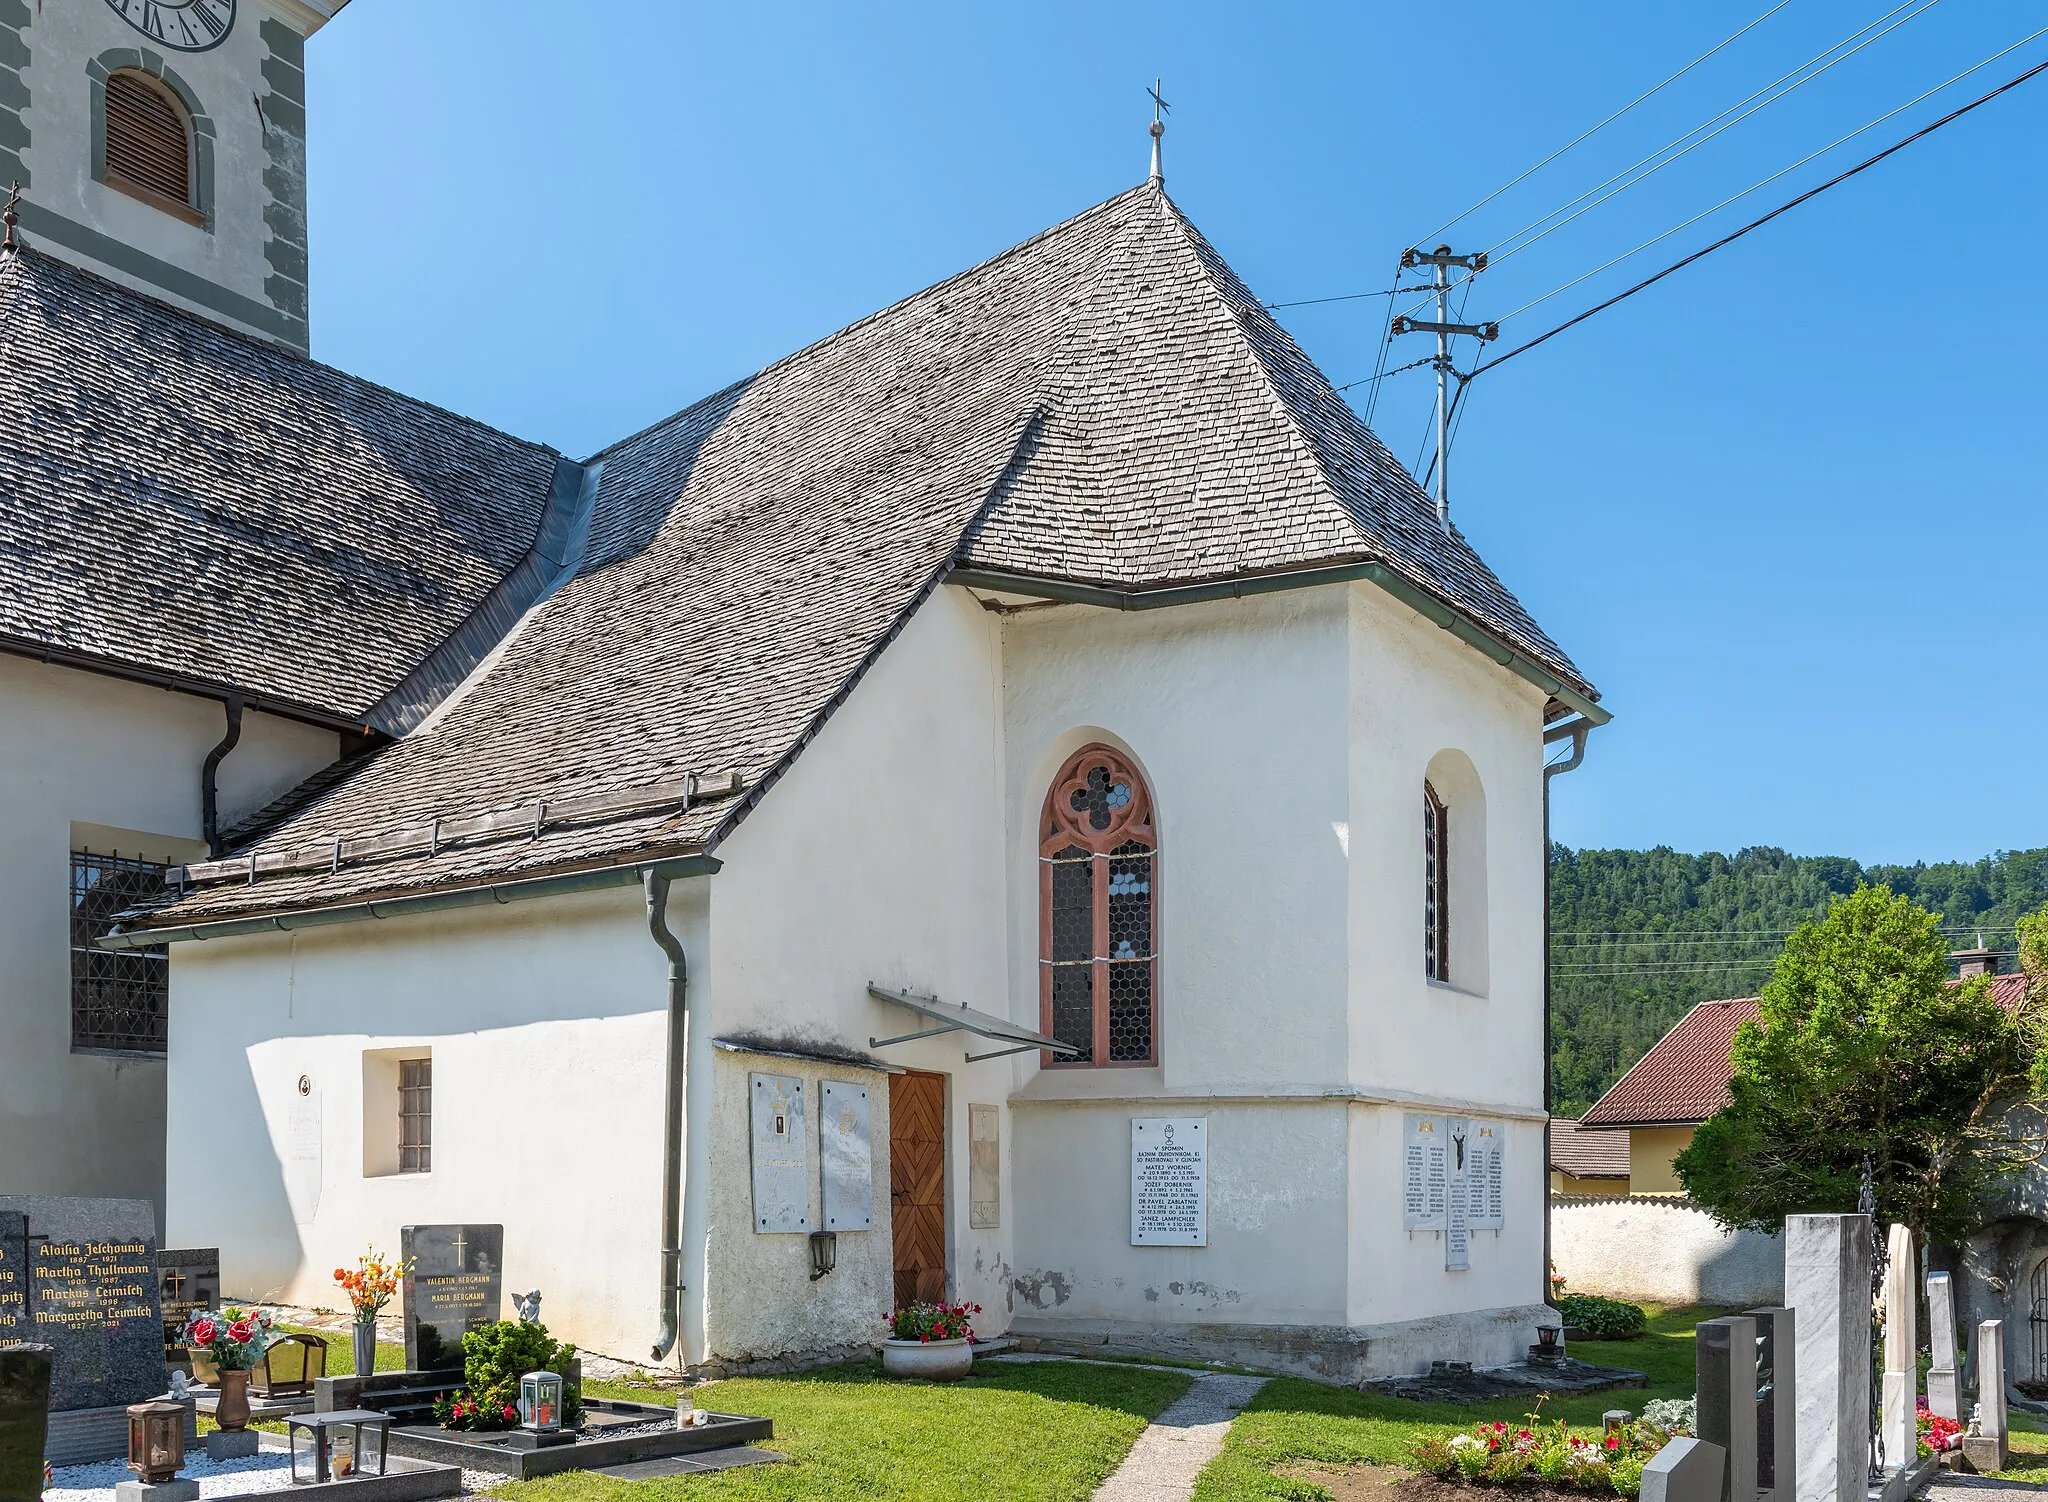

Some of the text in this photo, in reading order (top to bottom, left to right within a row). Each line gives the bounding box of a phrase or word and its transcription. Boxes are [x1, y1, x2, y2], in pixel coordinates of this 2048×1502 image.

[35, 1264, 149, 1278] Martha Thullmann
[67, 1278, 87, 1286] 1900
[426, 1276, 490, 1286] VALENTIN BERGMANN
[0, 1291, 23, 1304] pitz
[41, 1288, 89, 1301] Markus
[431, 1292, 485, 1302] MARIA BERGMANN
[99, 1298, 119, 1306] 1998
[35, 1309, 103, 1324] Margaretha
[68, 1322, 86, 1330] 1927
